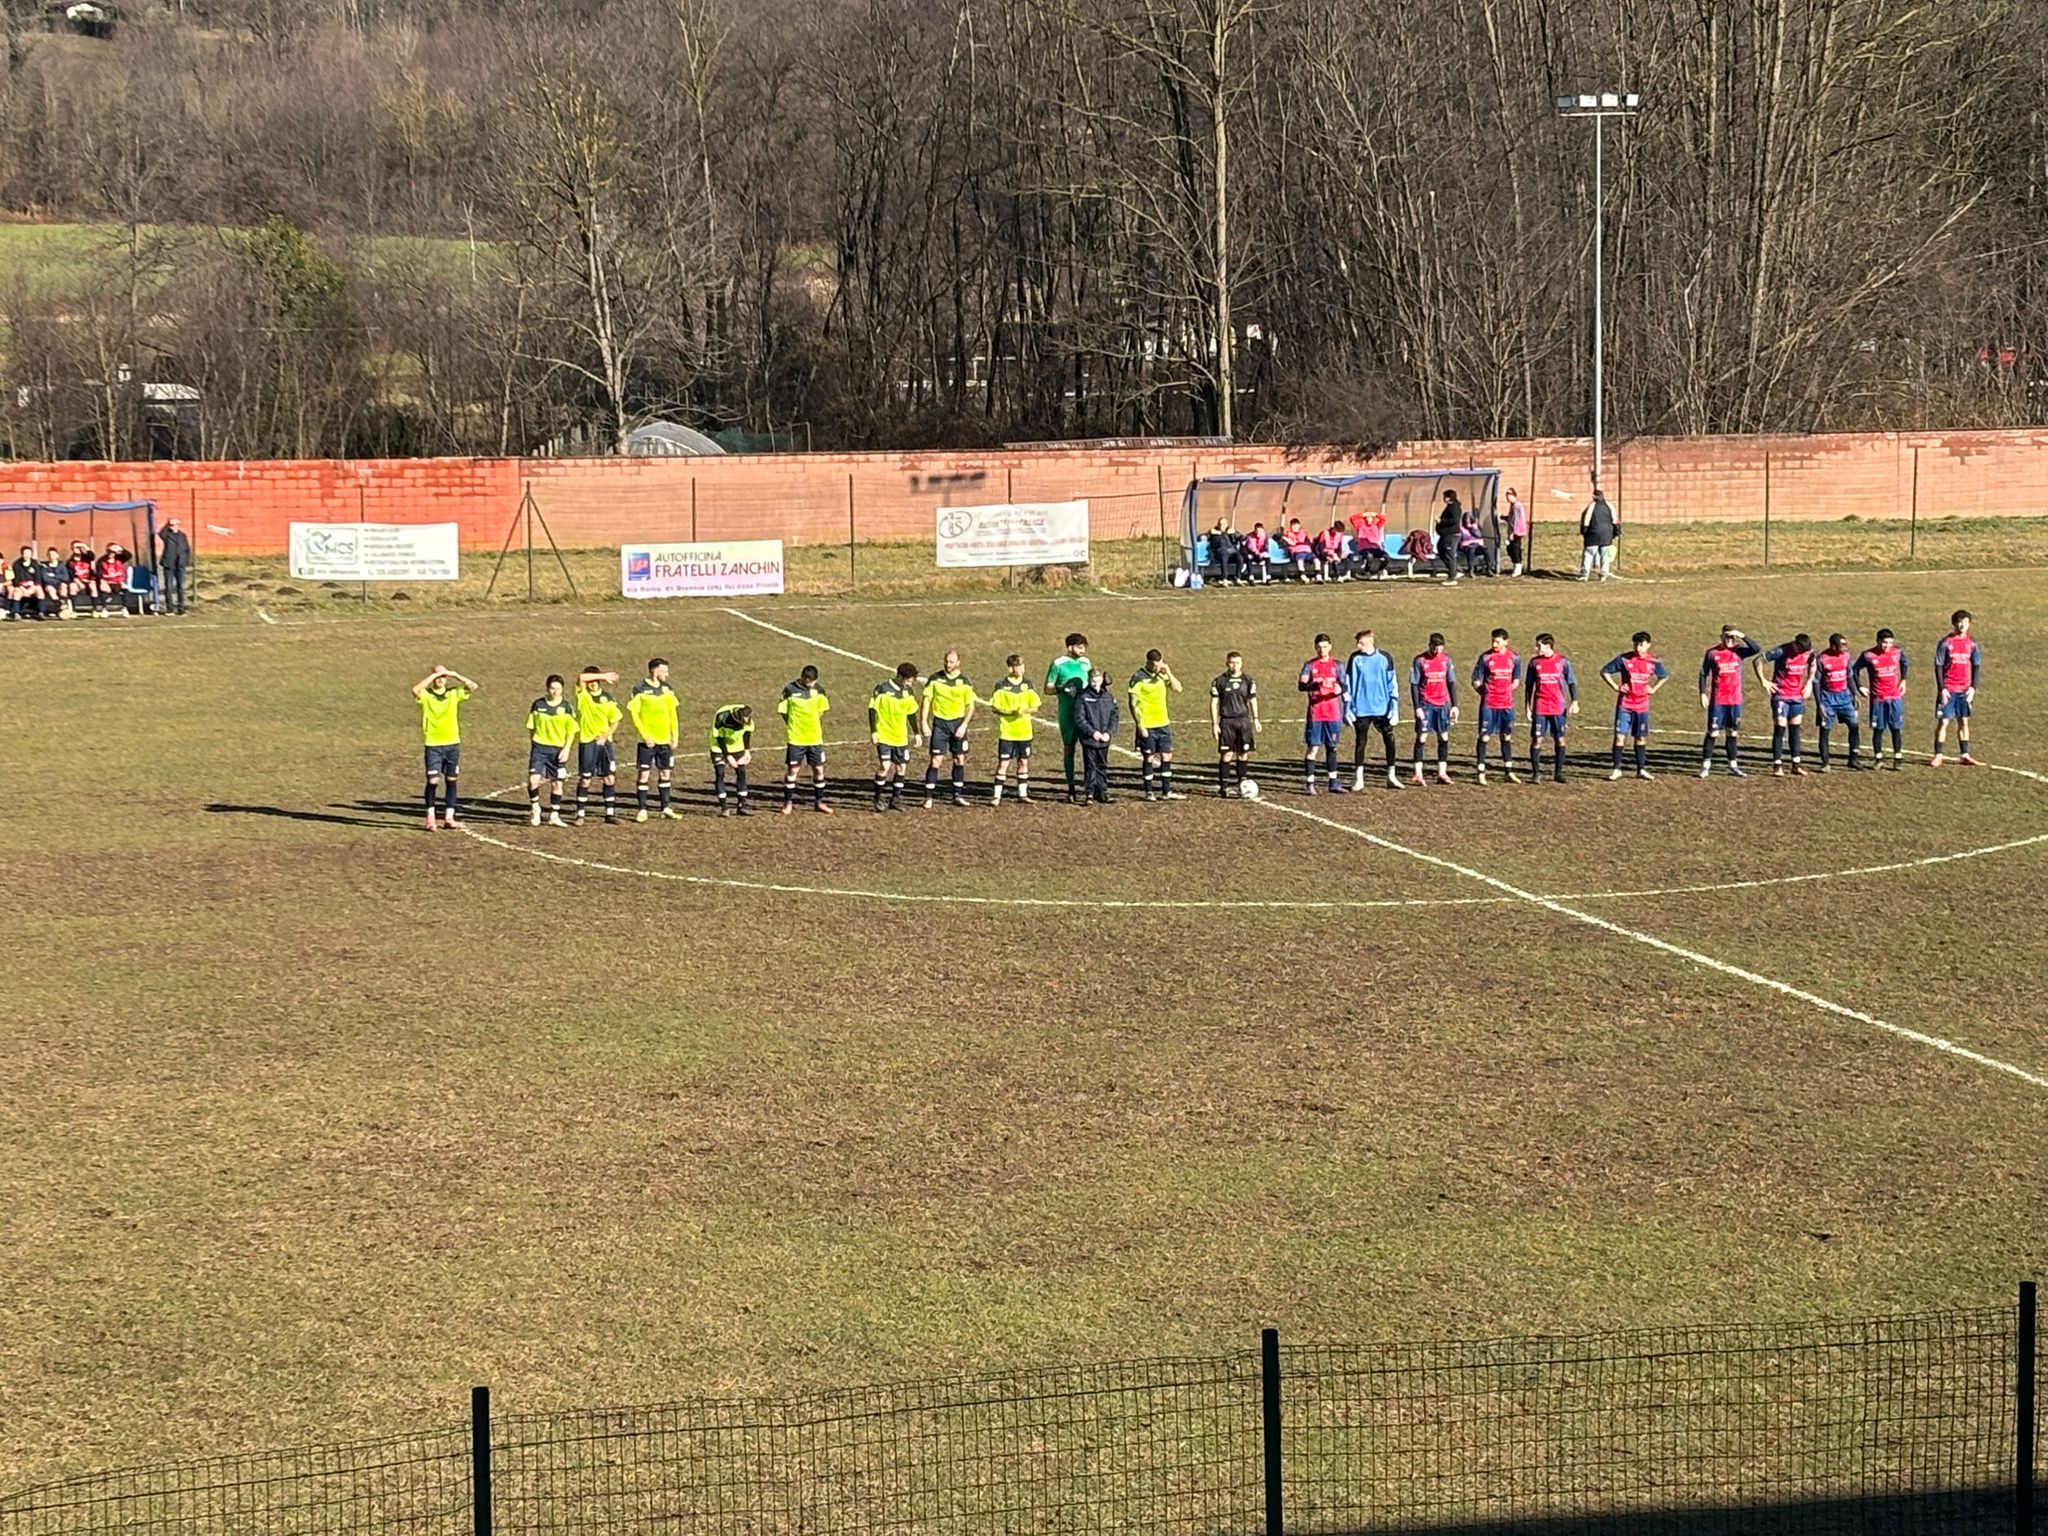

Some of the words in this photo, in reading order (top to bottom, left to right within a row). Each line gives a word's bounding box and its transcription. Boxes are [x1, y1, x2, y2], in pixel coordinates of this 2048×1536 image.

[655, 552, 722, 562] AUTOFFICINA
[655, 563, 716, 578] FRATELLI
[721, 561, 779, 576] ZANCHIN
